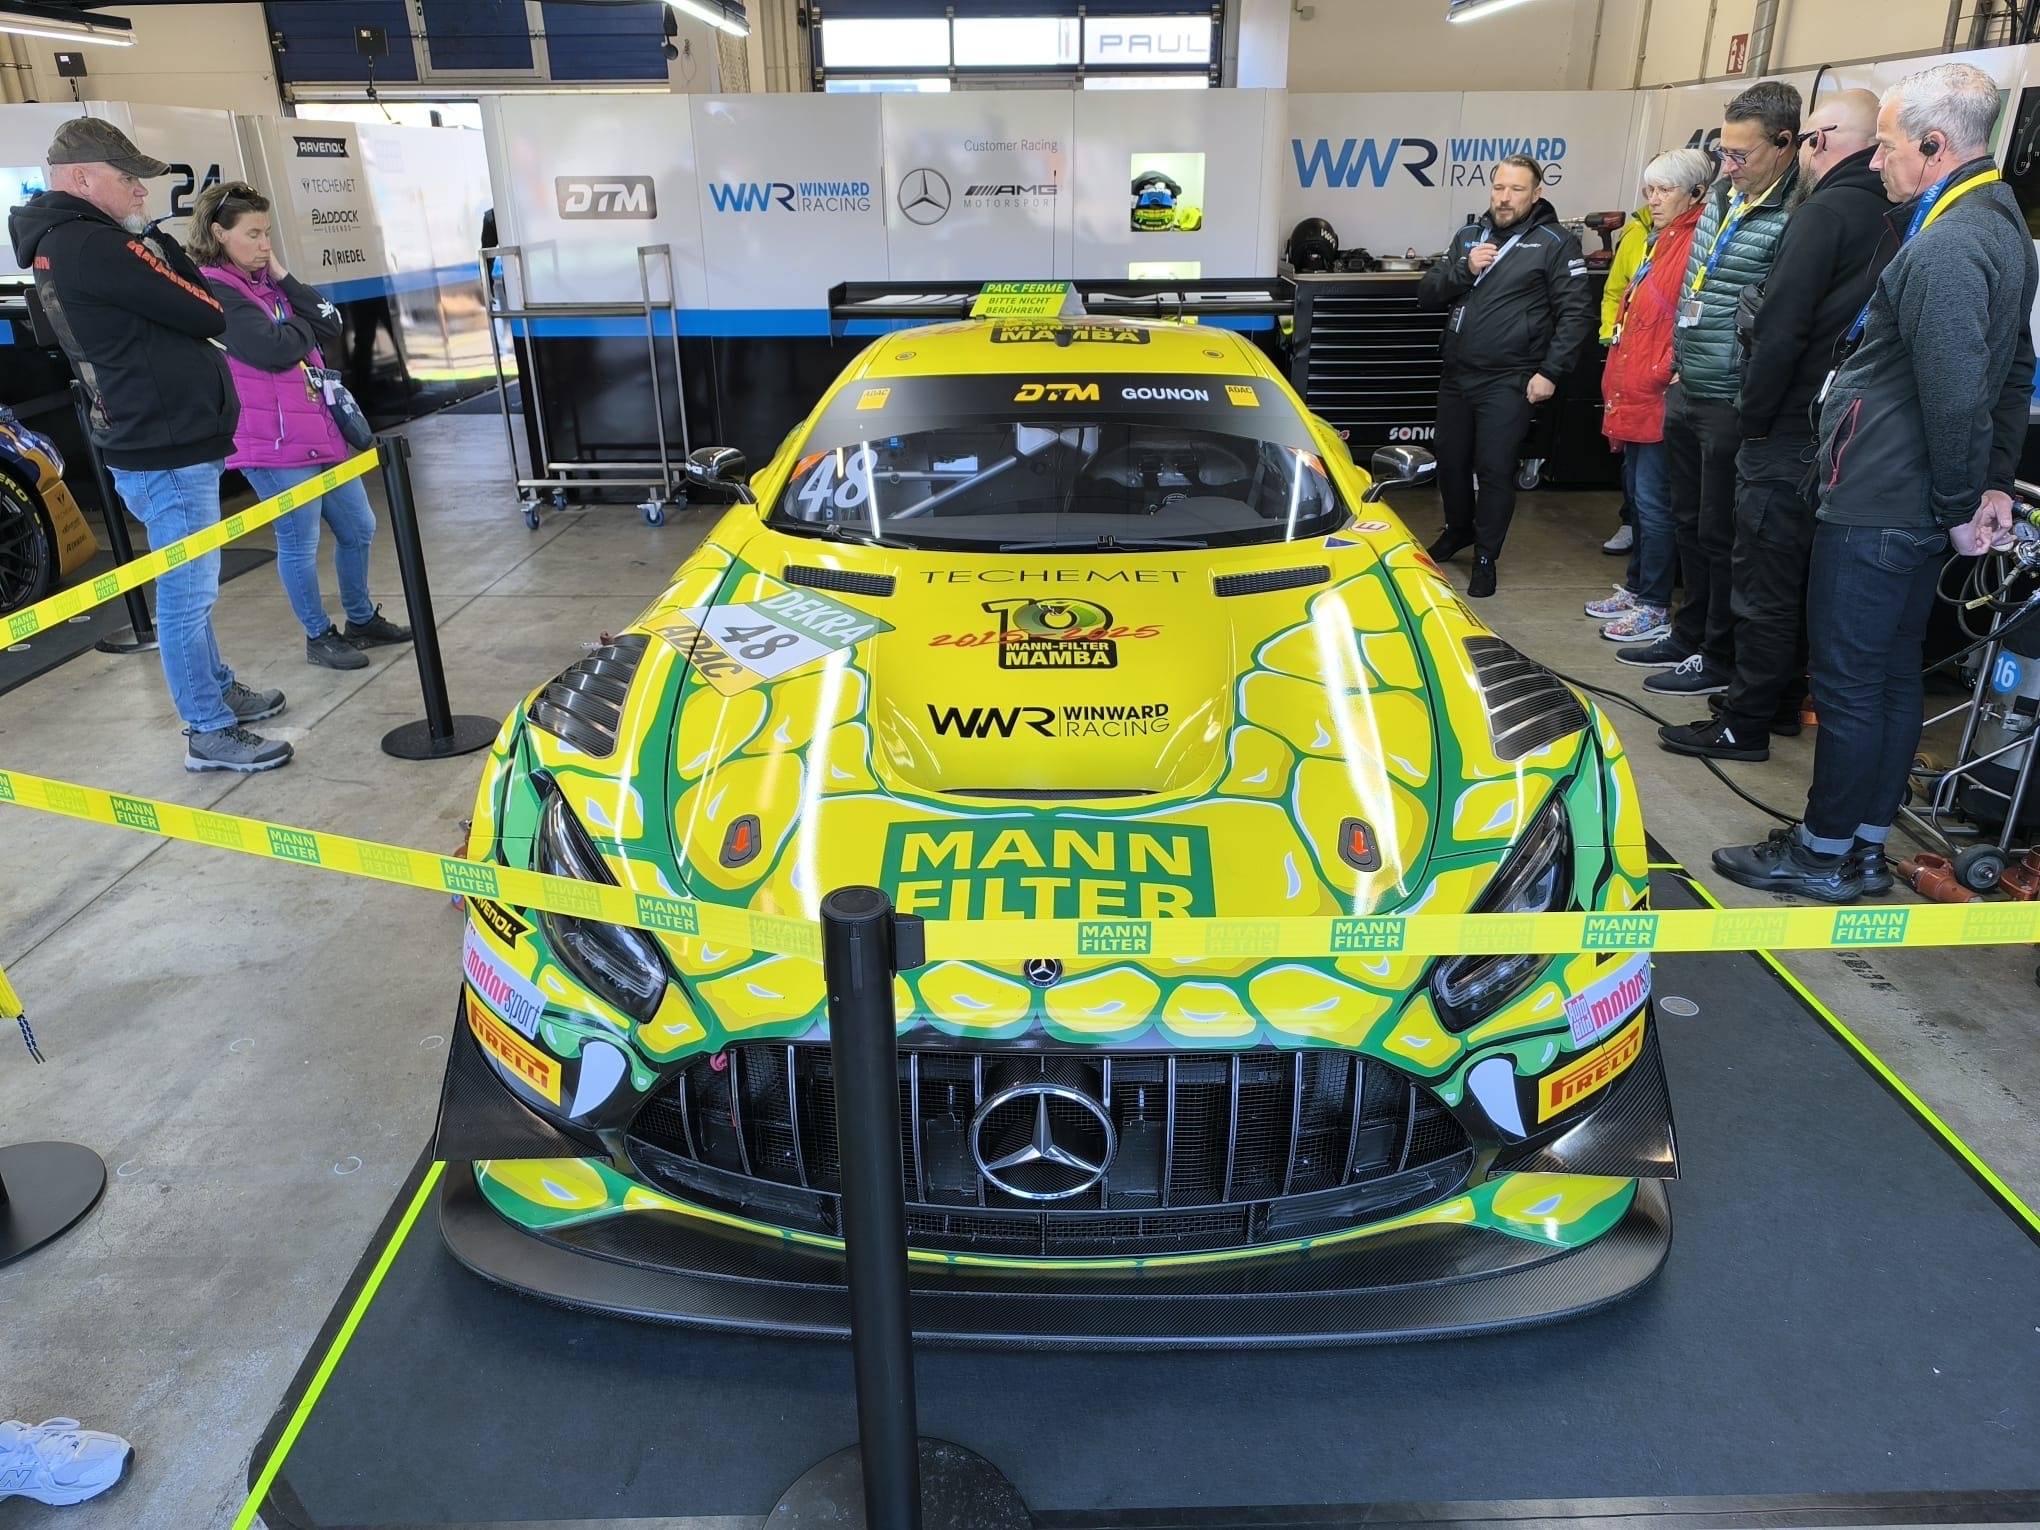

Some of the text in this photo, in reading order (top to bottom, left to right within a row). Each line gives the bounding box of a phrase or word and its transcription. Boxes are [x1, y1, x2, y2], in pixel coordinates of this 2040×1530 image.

[300, 141, 344, 154] RAVENOL
[964, 139, 1058, 154] Customer Racing
[1451, 137, 1567, 162] WINWARD
[311, 178, 356, 193] TECHEMET
[799, 182, 870, 197] WINWARD
[996, 184, 1058, 196] AMG
[565, 183, 649, 213] DTM
[802, 197, 871, 212] RACING
[964, 199, 1058, 208] MOTORSPORT
[337, 248, 366, 264] RIEDEL
[986, 284, 1065, 293] PARC FERME
[986, 305, 1044, 314] BERÜHREN!
[988, 297, 1050, 305] BITTE NICHT
[1013, 383, 1100, 401] DTM
[1121, 387, 1210, 402] GOUNON
[1227, 386, 1253, 395] ADAC
[798, 449, 878, 513] 48
[95, 574, 116, 590] MANN
[920, 570, 1188, 584] TECHEMET
[97, 583, 119, 600] FILTER
[10, 611, 35, 629] MANN
[760, 591, 876, 645] DEKRA
[13, 621, 39, 639] FILTER
[720, 624, 800, 660] 48
[1006, 641, 1110, 651] MANN-FILTER
[656, 625, 744, 678] ADAC
[1005, 652, 1111, 666] MAMBA
[1995, 656, 2017, 689] 16
[1063, 703, 1169, 721] WINWARD
[1065, 717, 1170, 737] RACING
[114, 799, 154, 816] MANN
[117, 811, 157, 829] FILTER
[270, 829, 315, 848] MANN
[273, 843, 318, 861] FILTER
[902, 830, 1192, 876] MANN
[444, 862, 494, 882] MANN
[447, 876, 496, 895] FILTER
[895, 876, 1195, 921] FILTER
[639, 897, 693, 918] MANN
[641, 911, 695, 932] FILTER
[1588, 918, 1654, 931] MANN
[1839, 913, 1905, 926] MANN
[1082, 925, 1148, 938] MANN
[1336, 922, 1400, 935] MANN
[1836, 927, 1901, 941] FILTER
[1082, 939, 1147, 951] FILTER
[1334, 936, 1400, 948] FILTER
[1586, 933, 1650, 945] FILTER
[468, 946, 540, 1034] motorsport
[470, 1005, 550, 1089] PIRELLI
[1550, 1025, 1641, 1109] PIRELLI
